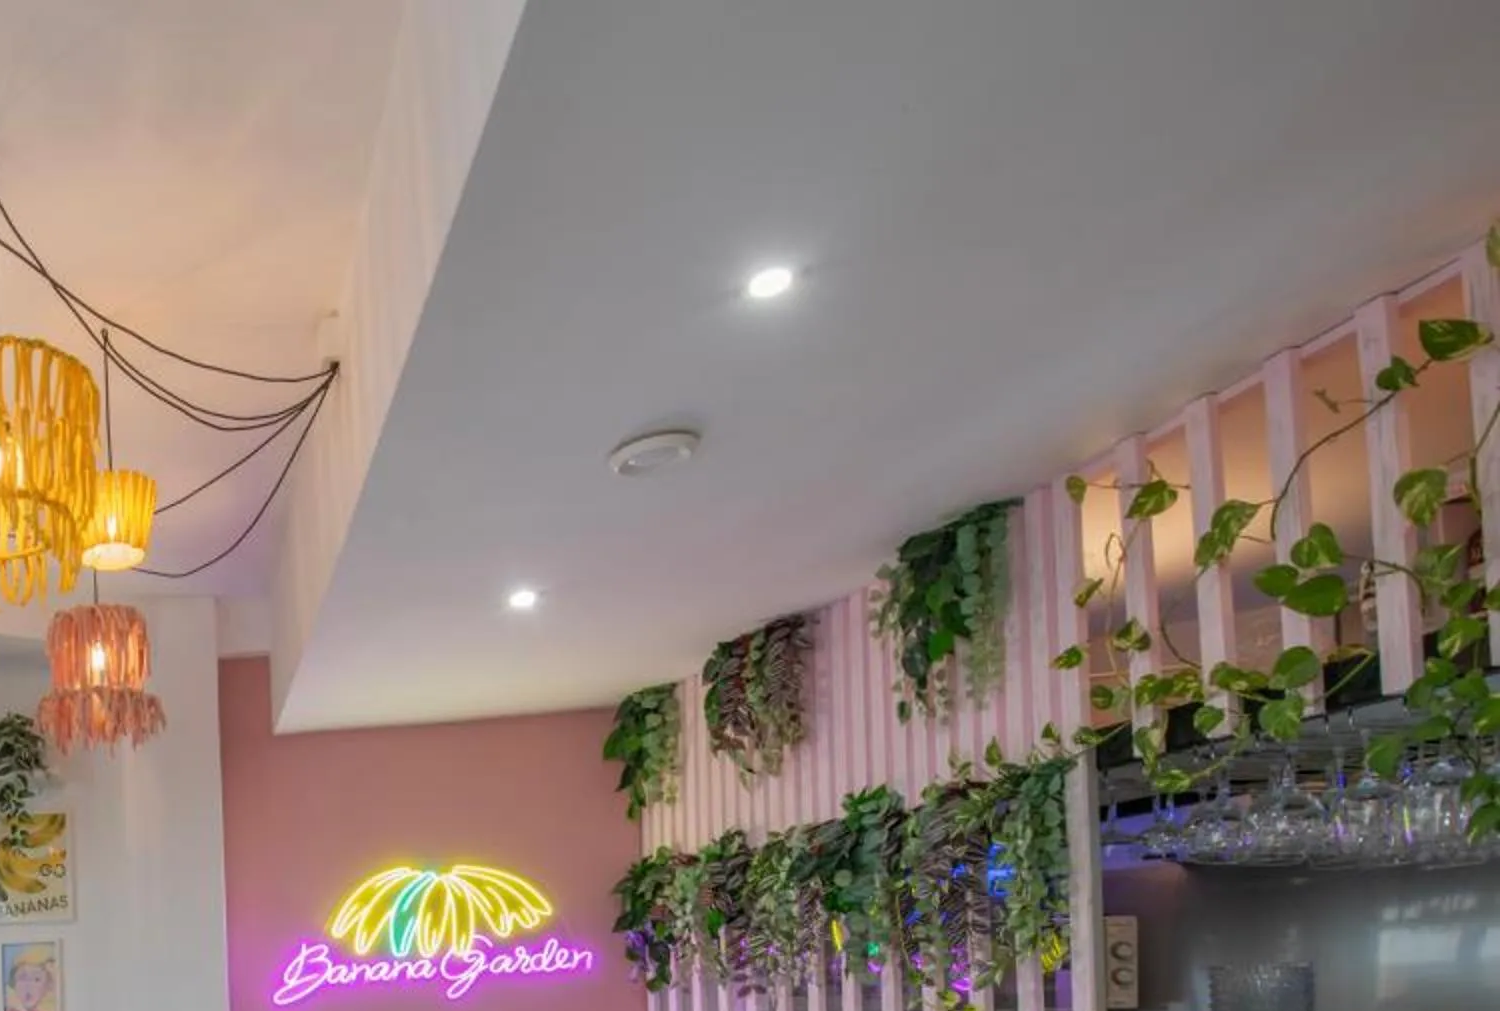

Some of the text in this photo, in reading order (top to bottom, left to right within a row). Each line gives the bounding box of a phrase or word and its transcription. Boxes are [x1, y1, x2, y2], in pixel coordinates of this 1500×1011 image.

[40, 863, 67, 878] GO
[273, 933, 593, 1004] Banana Garden
